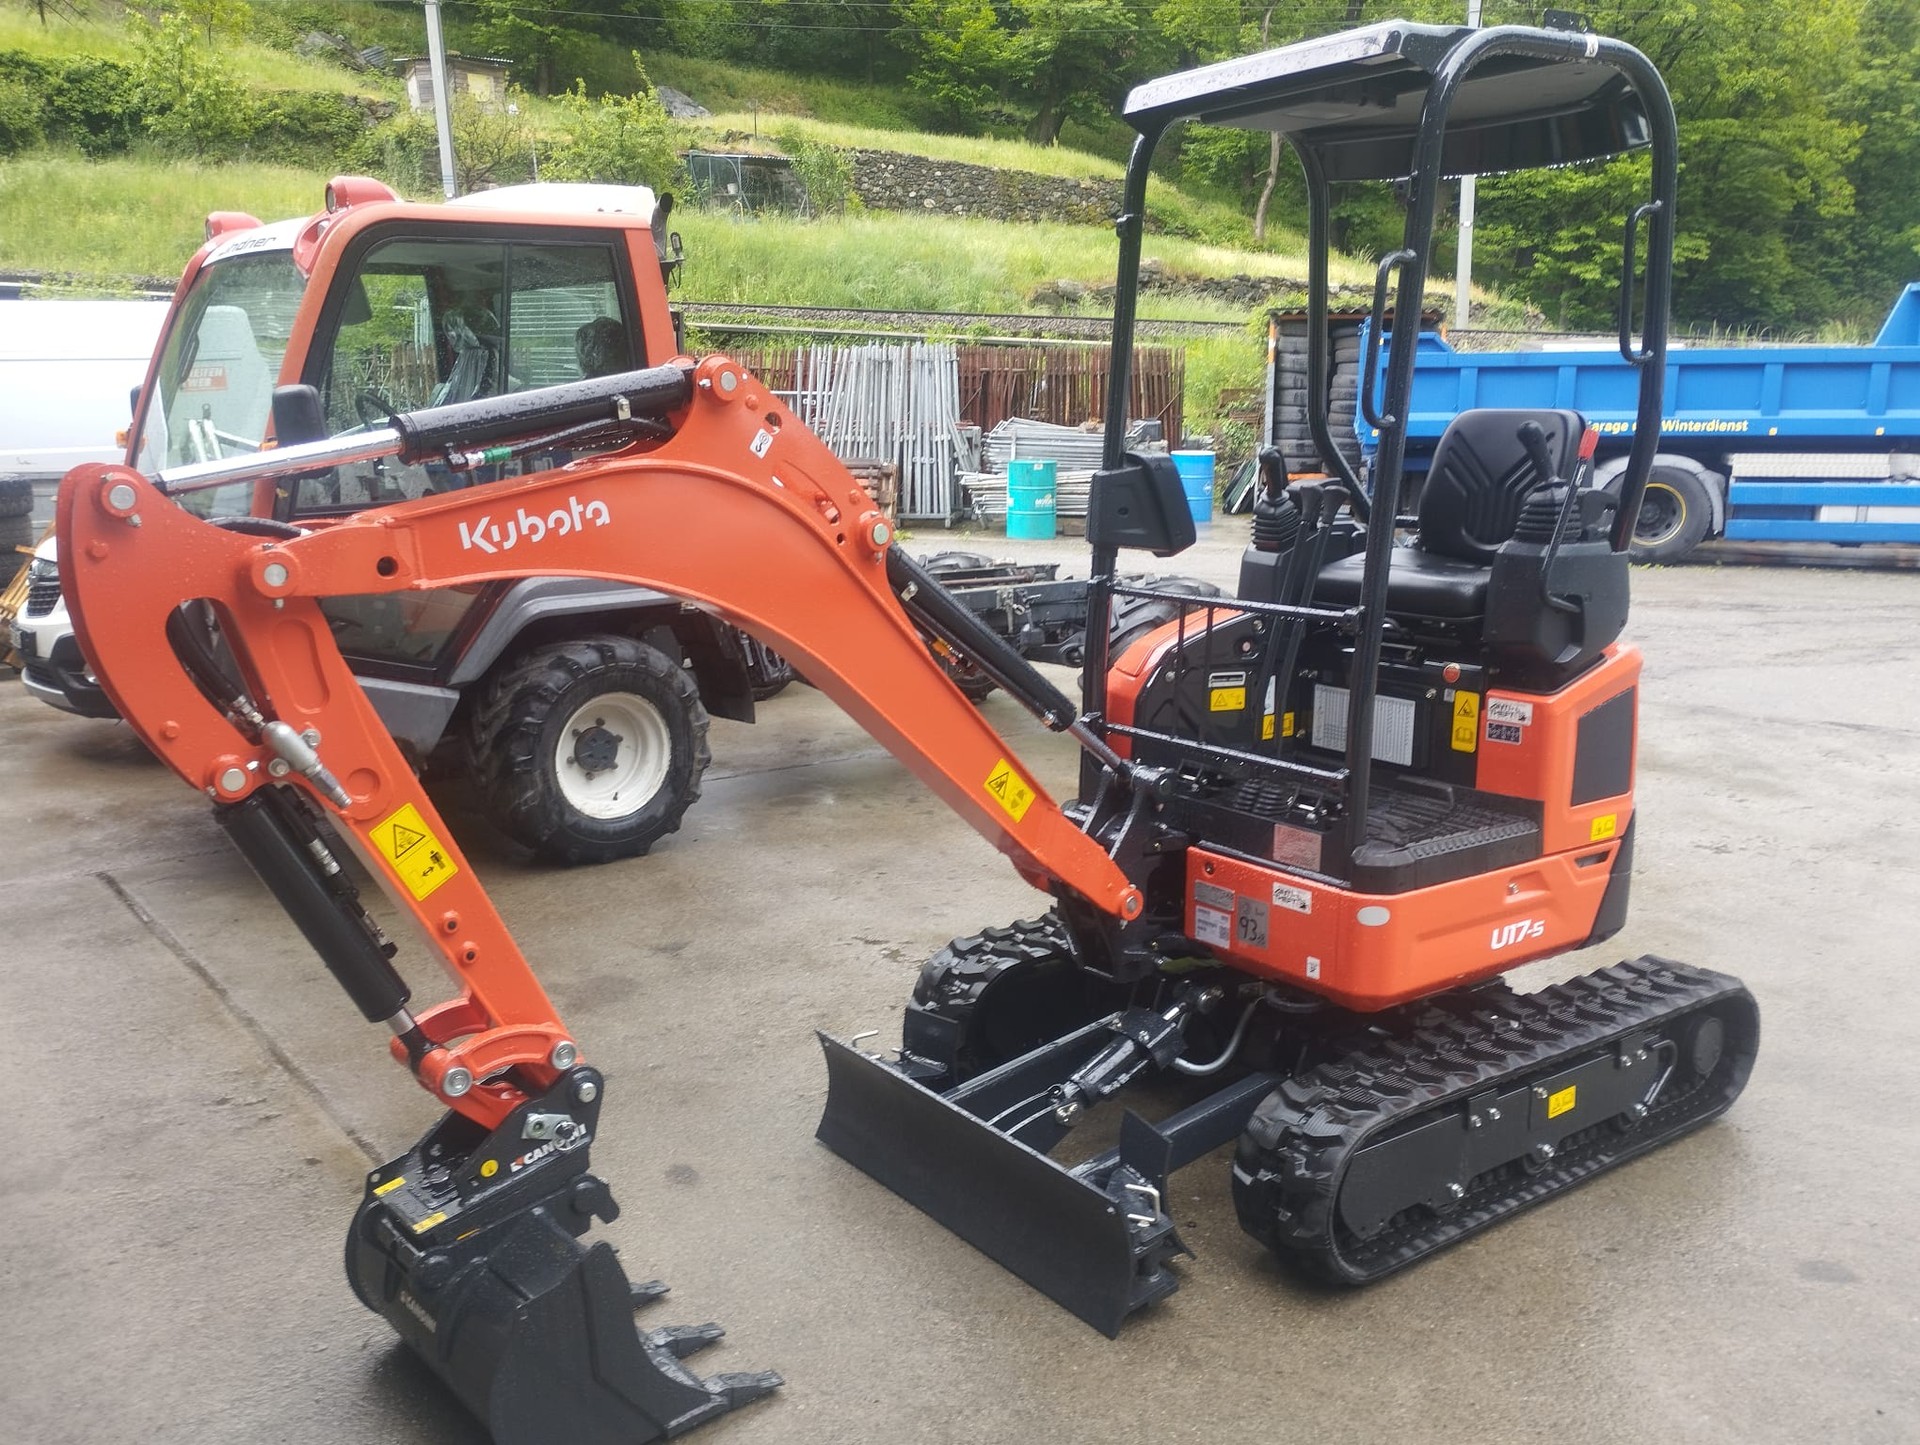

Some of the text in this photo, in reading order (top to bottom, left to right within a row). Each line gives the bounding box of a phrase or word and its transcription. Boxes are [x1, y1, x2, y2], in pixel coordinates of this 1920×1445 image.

[1588, 420, 1629, 434] arage
[1661, 418, 1748, 432] Winterdienst
[458, 495, 611, 554] Kubota
[1239, 915, 1258, 942] 93
